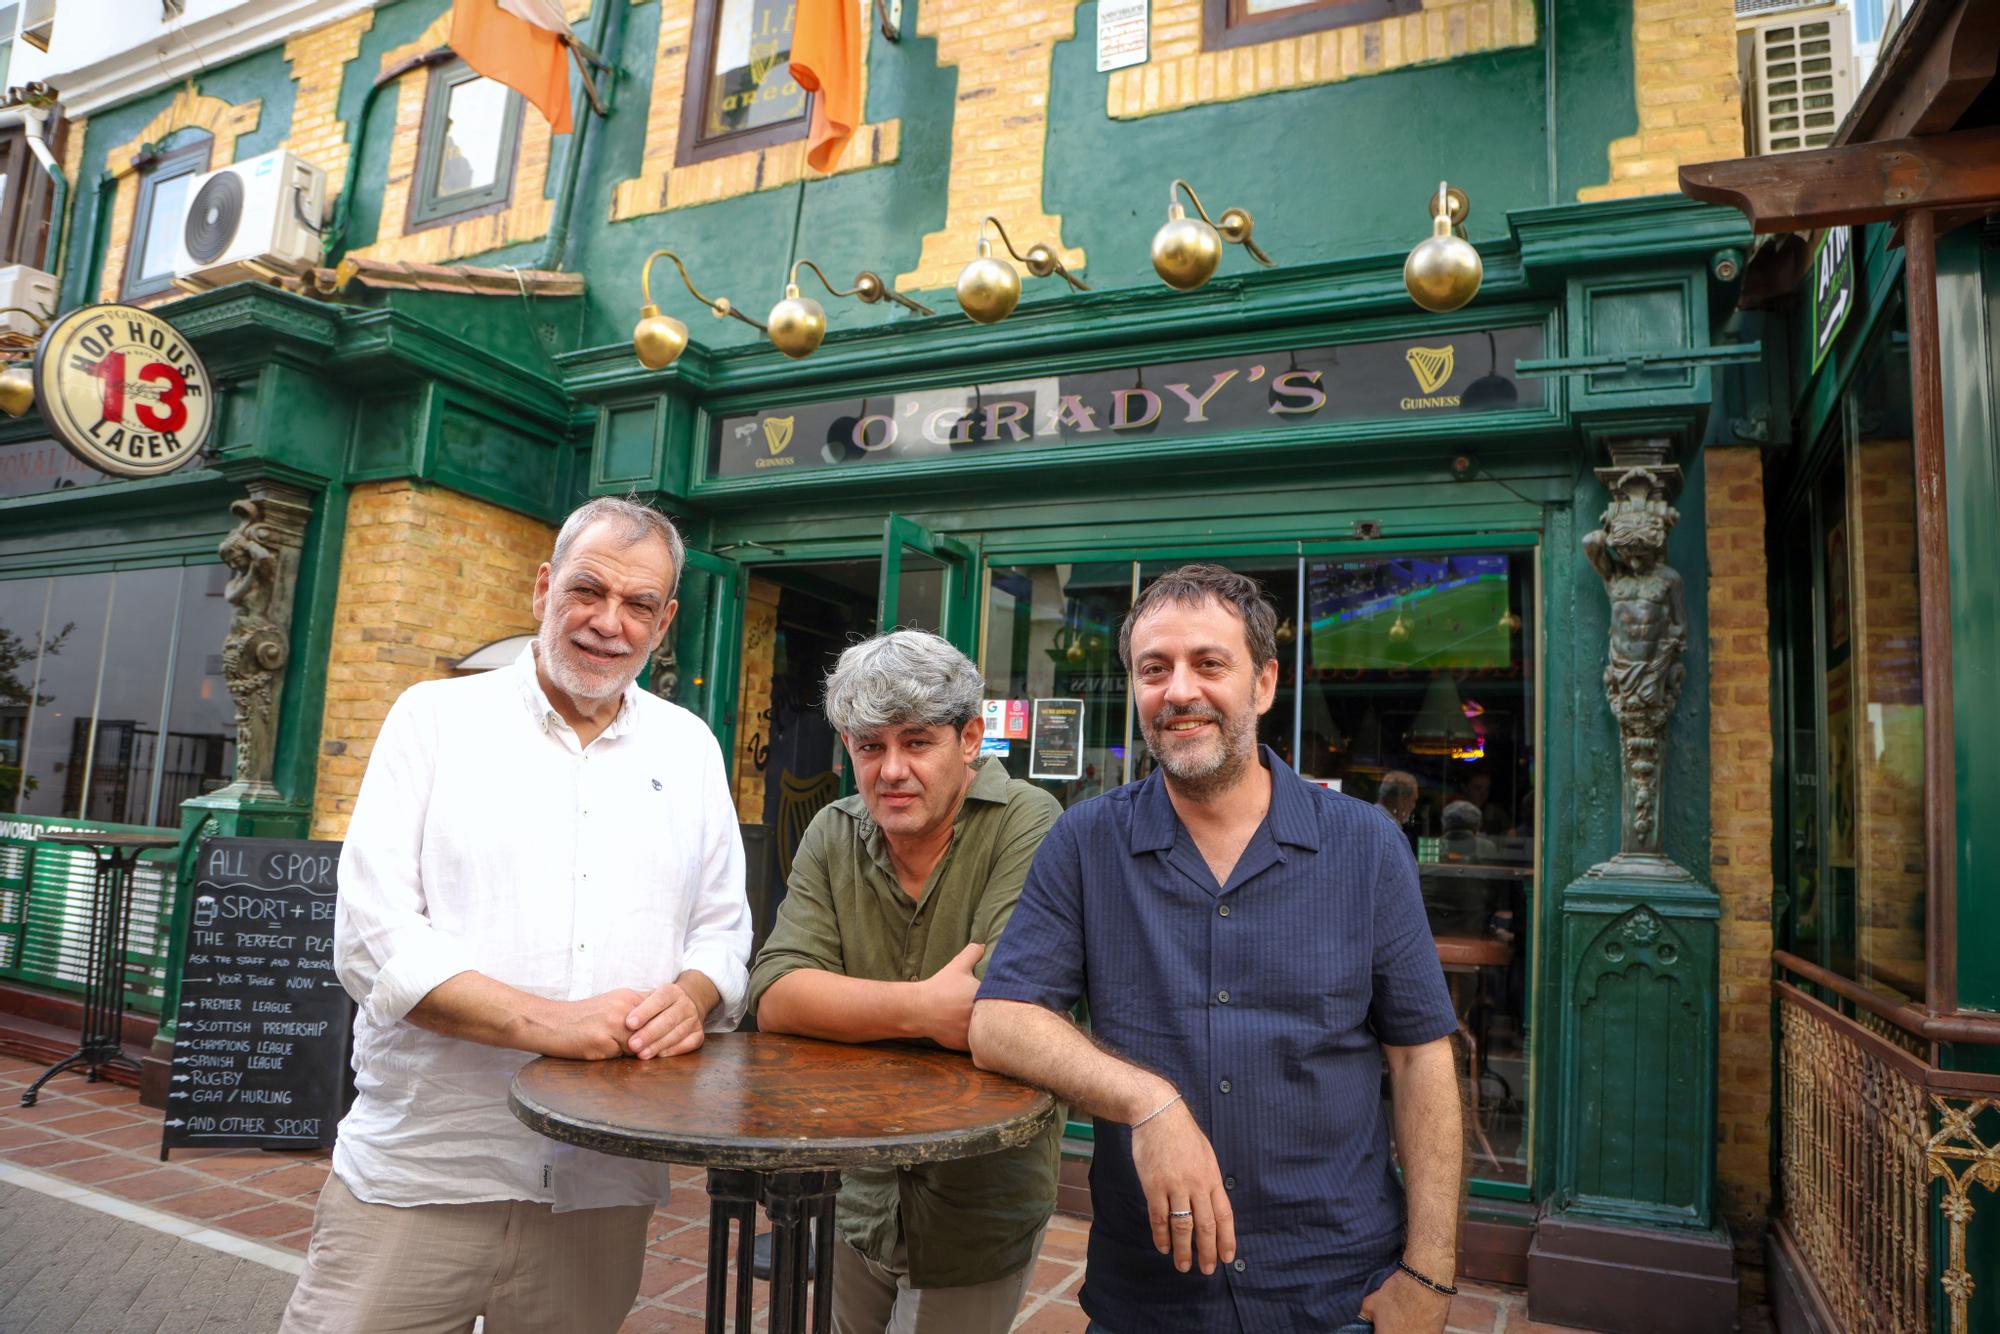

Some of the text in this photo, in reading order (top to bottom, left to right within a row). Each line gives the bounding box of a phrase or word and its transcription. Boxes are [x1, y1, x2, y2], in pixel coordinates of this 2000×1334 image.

[70, 320, 203, 398] HOP HOUSE
[86, 350, 188, 433] 13
[851, 364, 1327, 452] O'GRADY'S
[1400, 394, 1461, 410] GUINNESS
[88, 416, 182, 458] LAGER
[755, 456, 795, 468] GUINNESS
[0, 820, 44, 841] WORLD
[209, 849, 248, 877] ALL
[221, 895, 288, 920] SPORT
[193, 930, 225, 946] THE
[236, 933, 297, 949] PERFECT
[189, 954, 209, 964] ASK
[236, 956, 266, 966] STAFF
[217, 973, 316, 990] YOUR TABLE NOW
[200, 998, 293, 1014] PREMIER LEAGUE
[193, 1020, 328, 1037] SCOTTISH PREMIERSHIP
[190, 1039, 294, 1055] CHAMPIONS LEAGUE
[188, 1055, 285, 1070] SPANISH LEAGUE
[191, 1070, 243, 1085] RUGBY
[192, 1090, 224, 1103] GAA
[241, 1090, 293, 1105] HURLING
[186, 1116, 322, 1135] AND OTHER SPORT
